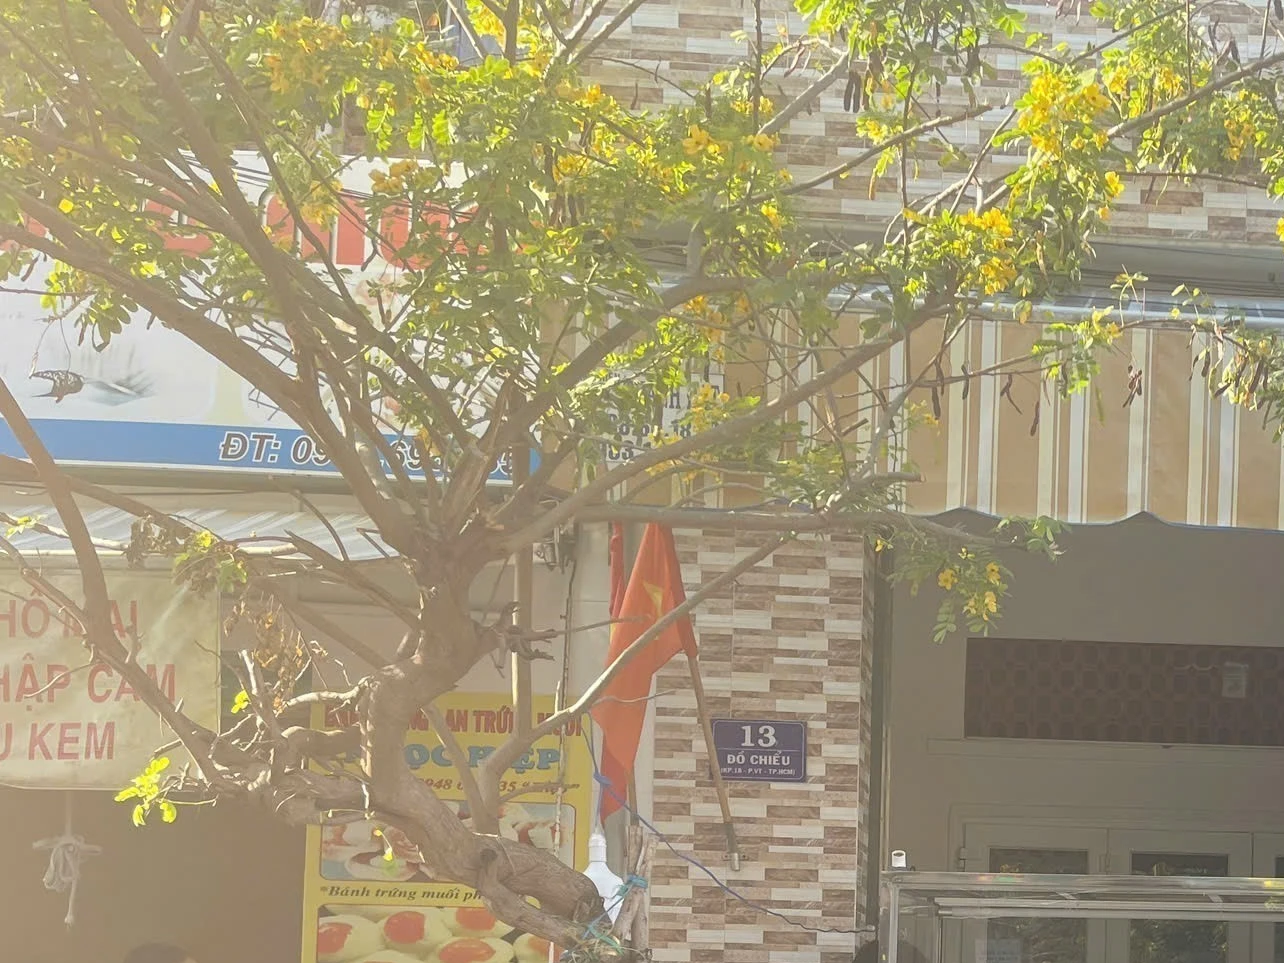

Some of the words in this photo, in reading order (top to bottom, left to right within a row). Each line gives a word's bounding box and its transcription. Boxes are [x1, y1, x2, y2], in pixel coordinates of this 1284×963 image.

[219, 431, 282, 463] ĐT:
[28, 721, 116, 761] KEM
[741, 725, 777, 748] 13
[327, 885, 370, 898] Bánh
[375, 885, 416, 901] trứng
[422, 887, 460, 900] muối
